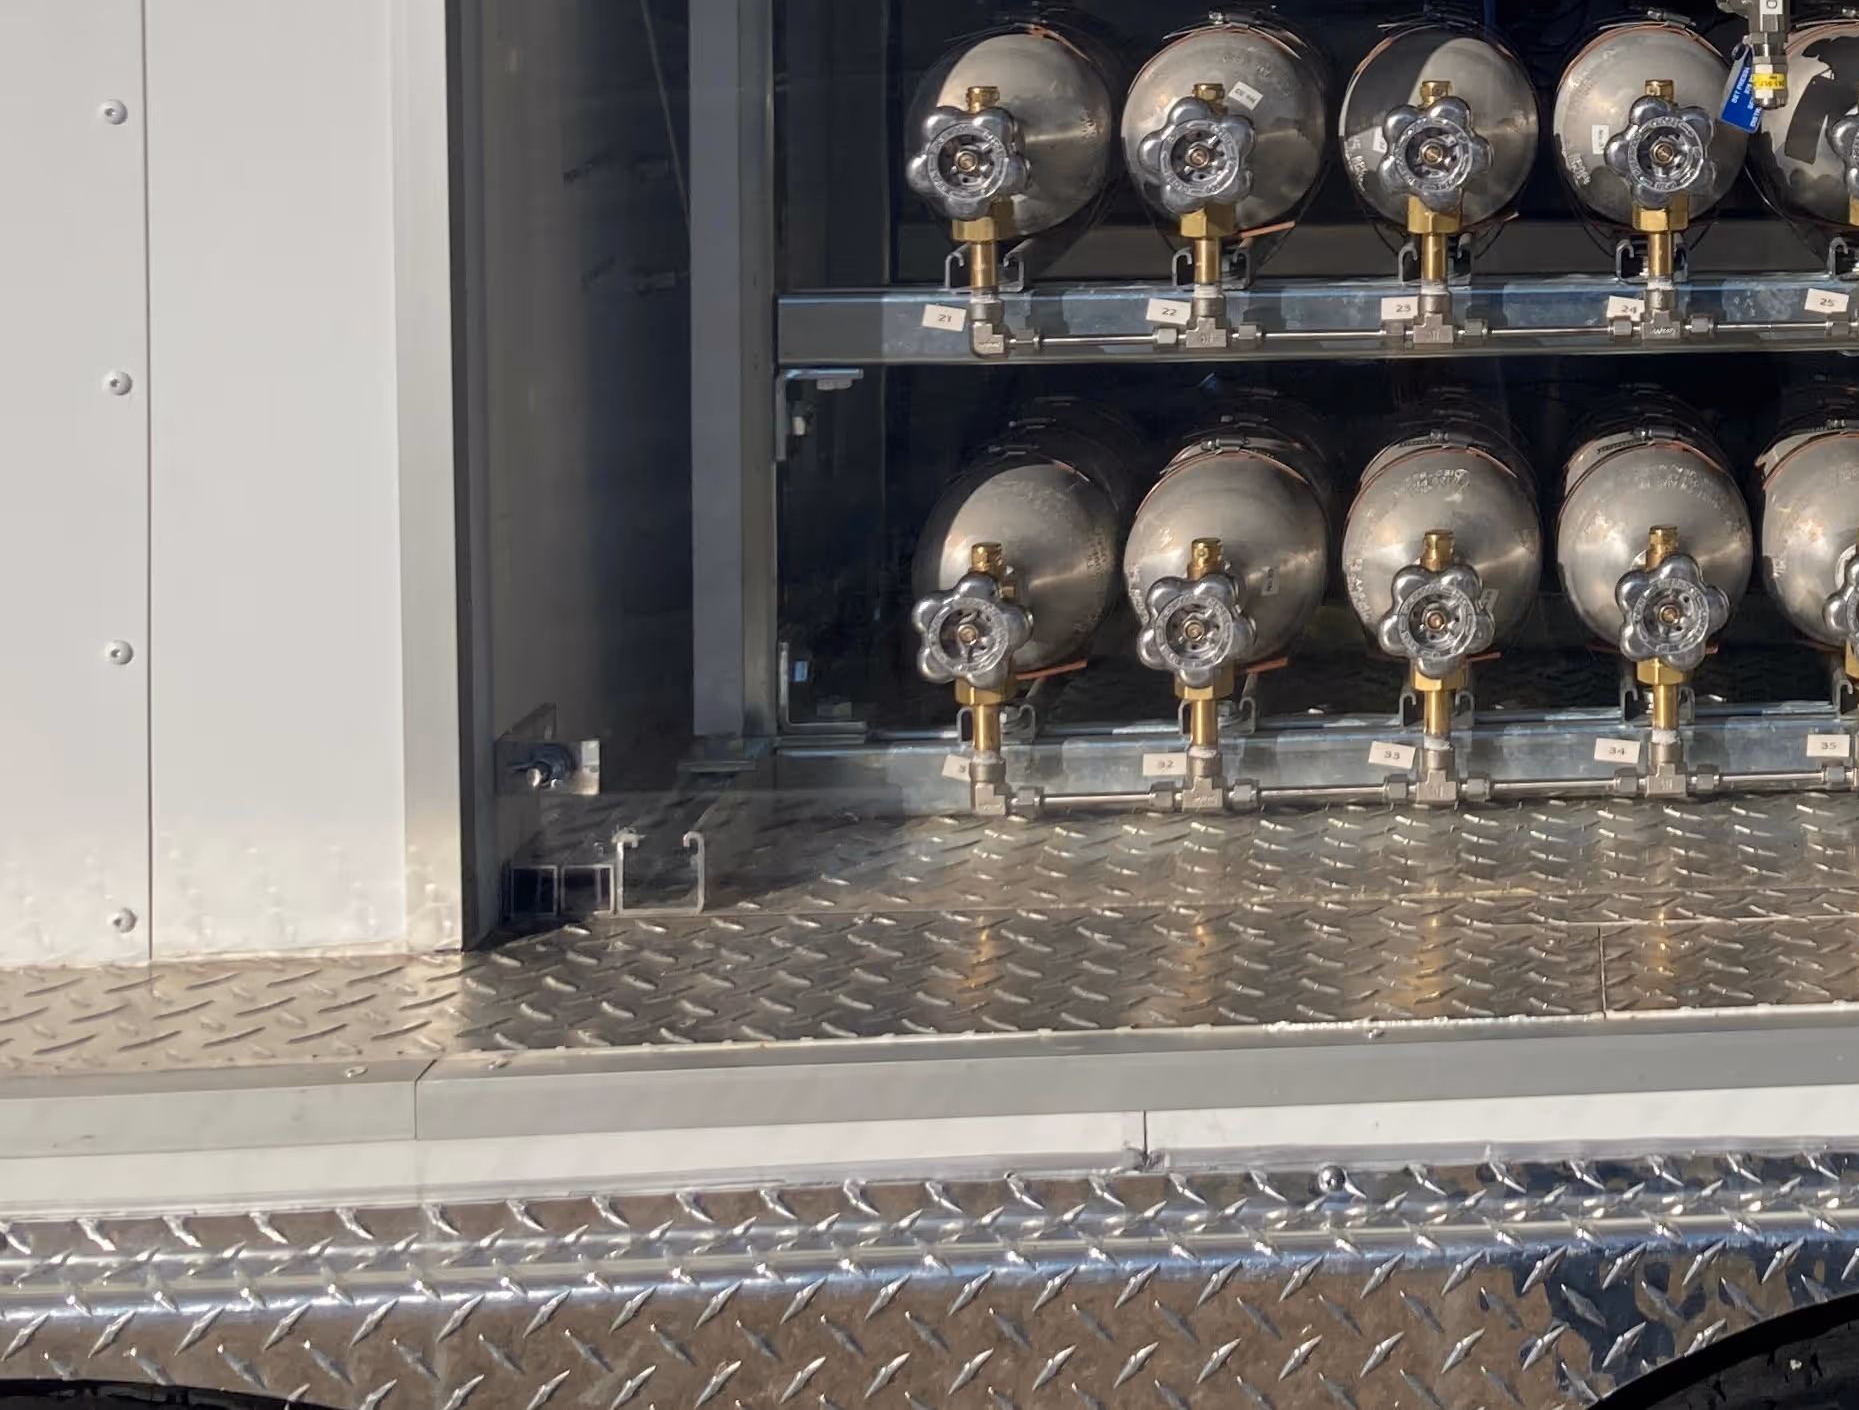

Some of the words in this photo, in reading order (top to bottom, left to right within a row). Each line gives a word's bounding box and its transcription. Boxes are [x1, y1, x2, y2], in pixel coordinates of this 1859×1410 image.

[1819, 297, 1835, 307] 25
[1162, 307, 1177, 317] 22
[1621, 305, 1637, 315] 24
[938, 313, 952, 323] 21
